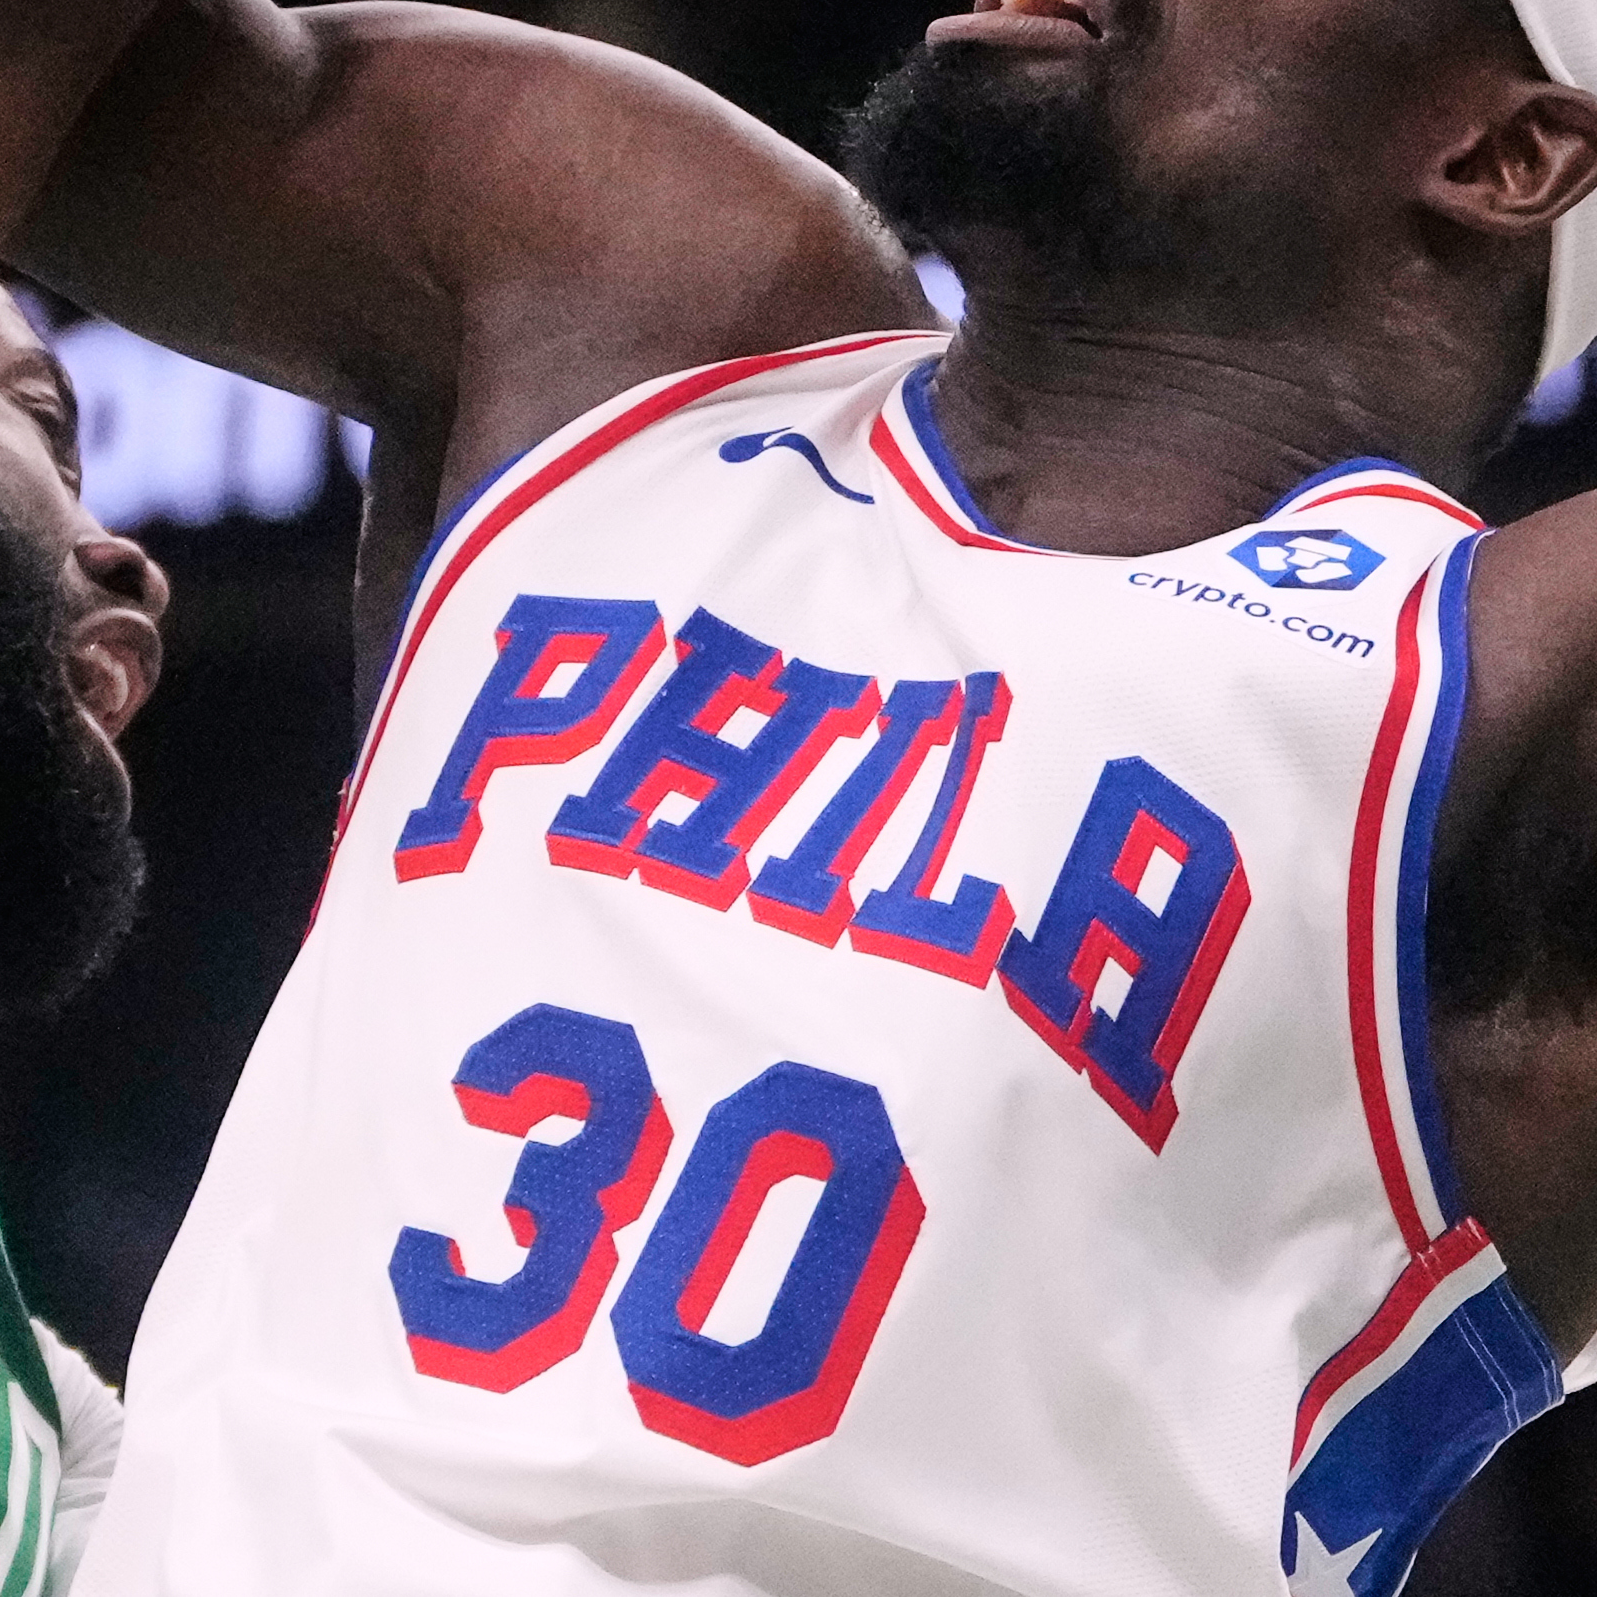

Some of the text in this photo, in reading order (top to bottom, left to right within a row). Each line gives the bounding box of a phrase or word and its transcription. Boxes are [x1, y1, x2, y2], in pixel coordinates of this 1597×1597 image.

[1127, 570, 1376, 659] crypto.com
[393, 593, 1252, 1156] PHILA
[388, 1003, 926, 1467] 30
